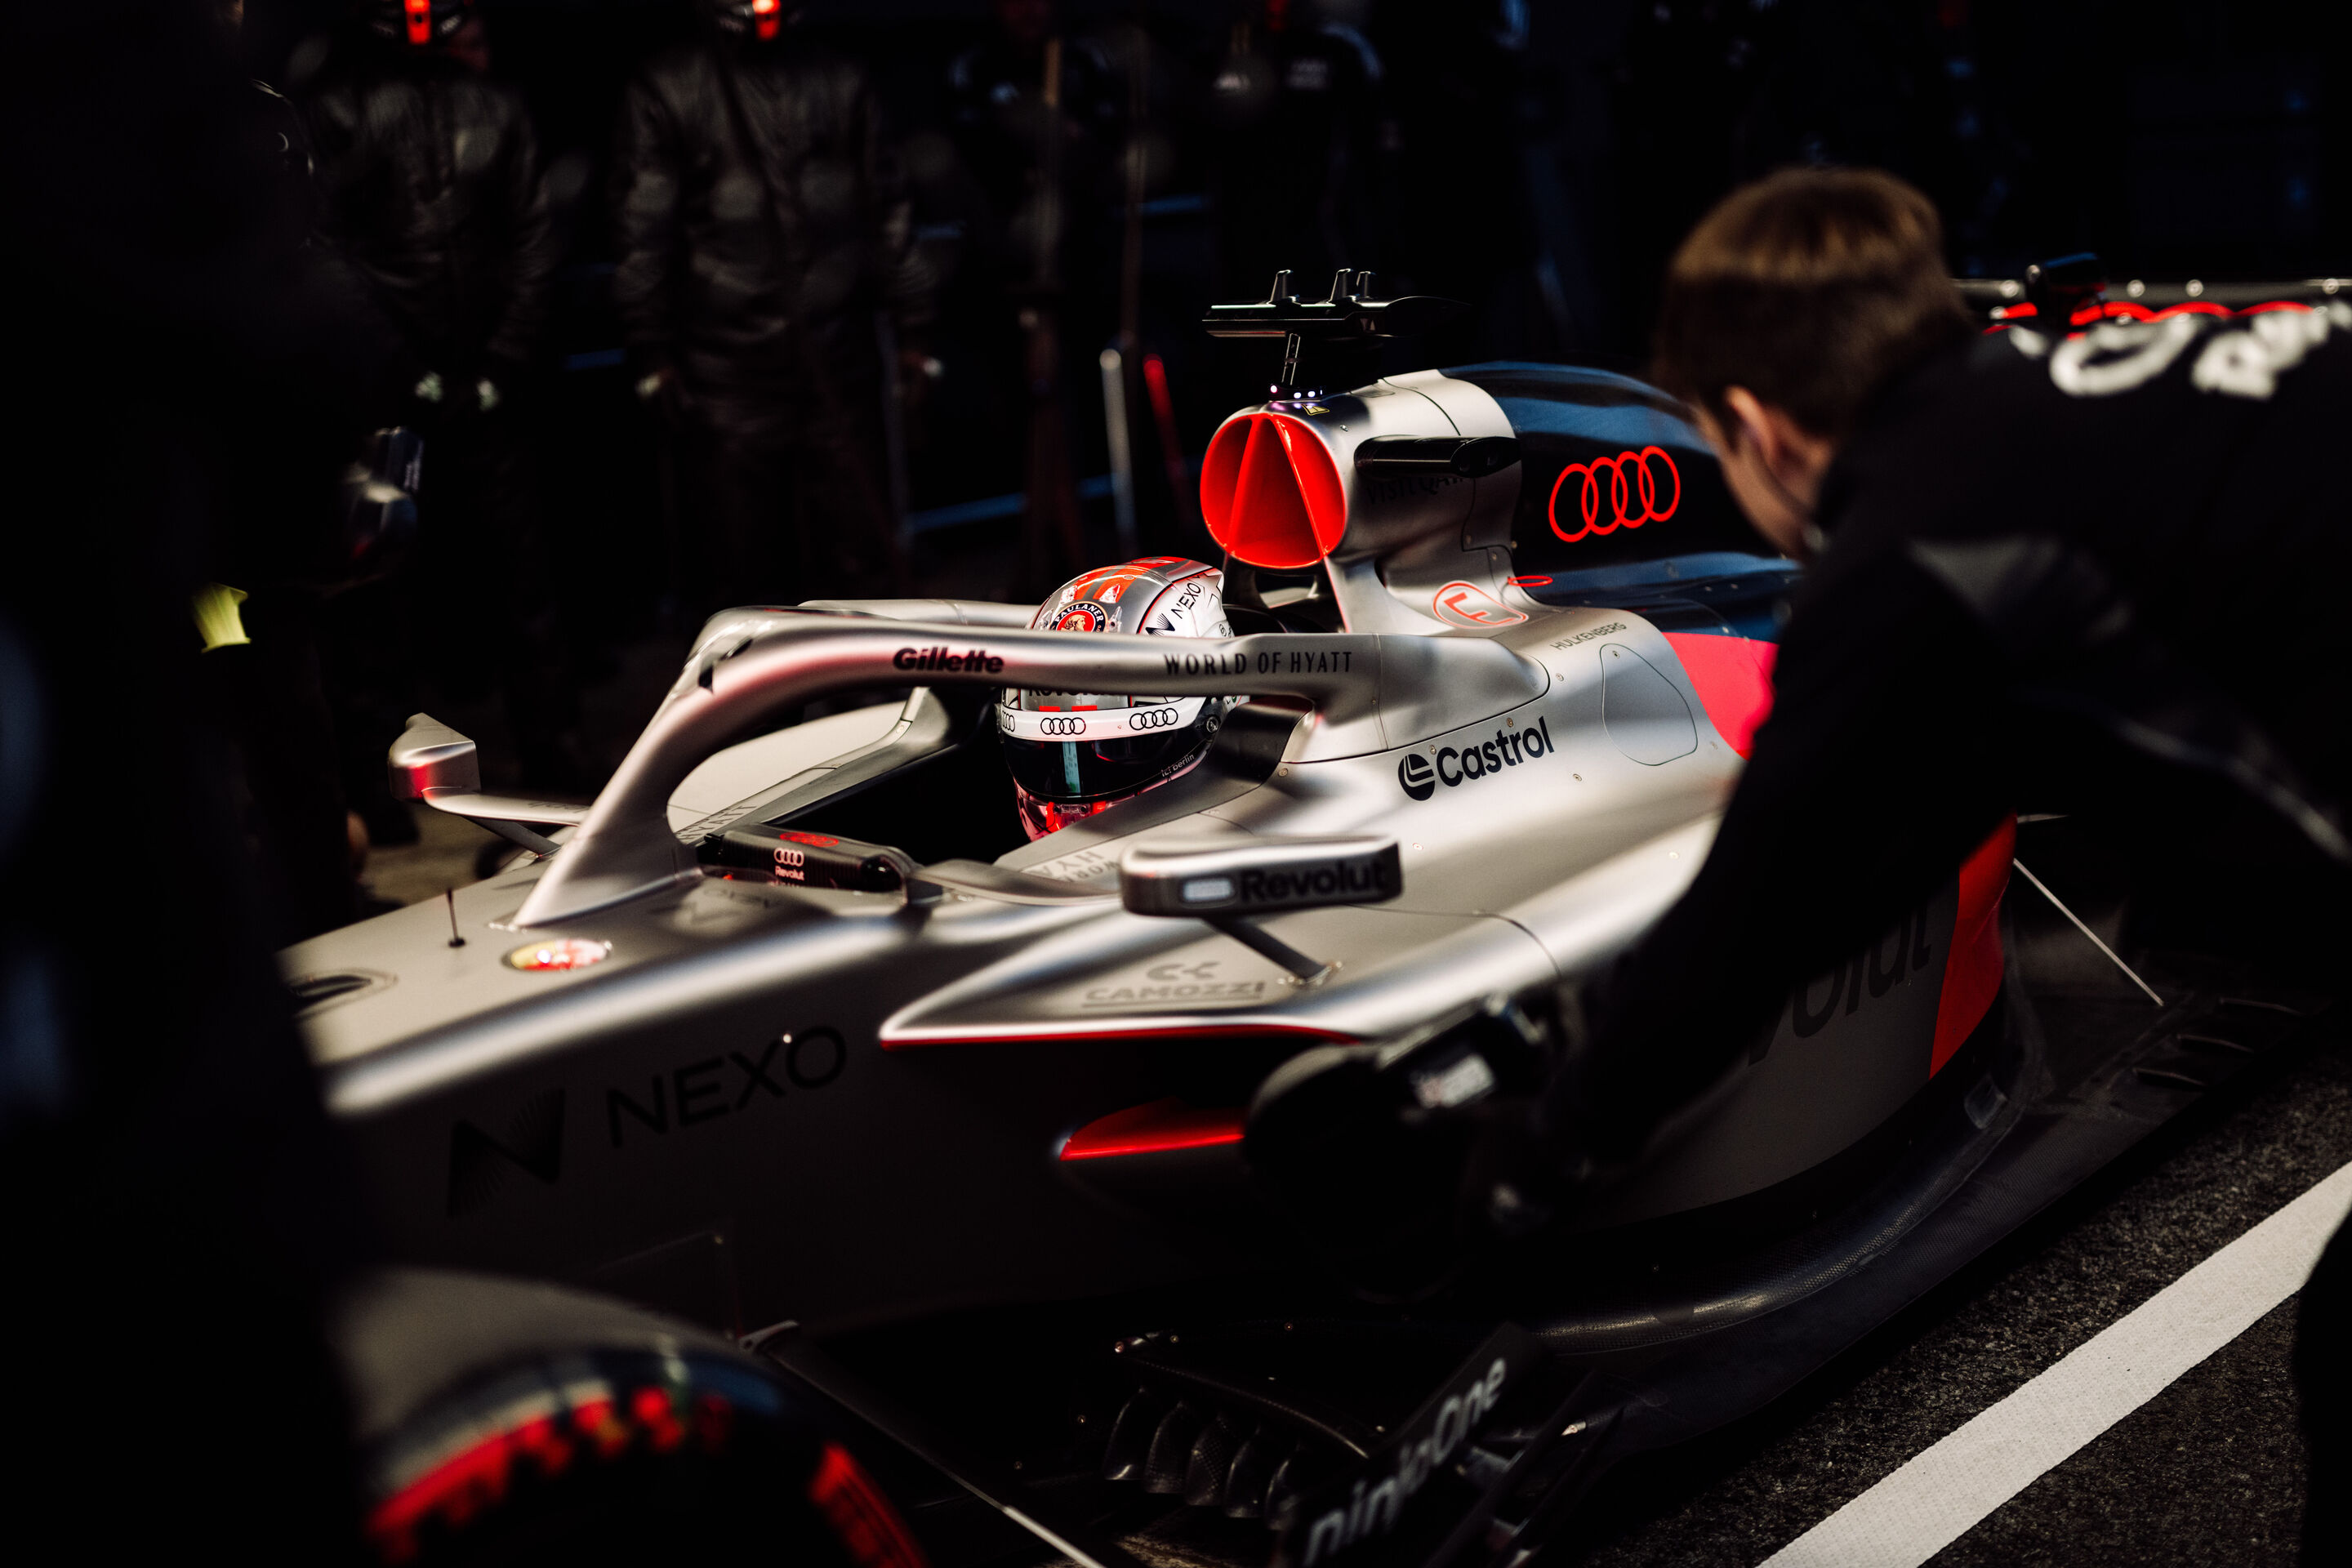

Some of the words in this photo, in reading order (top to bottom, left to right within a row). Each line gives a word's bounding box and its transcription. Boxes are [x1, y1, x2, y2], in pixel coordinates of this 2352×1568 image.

[1550, 622, 1627, 650] HULKENBERG
[893, 646, 1004, 674] Gillette
[1165, 653, 1247, 675] WORLD
[1258, 653, 1282, 675] OF
[1290, 651, 1352, 674] HYATT
[1437, 715, 1555, 786] Castrol
[1240, 862, 1387, 902] Revolut
[1087, 981, 1266, 1001] CAMOZZI
[608, 1026, 846, 1147] NEXO
